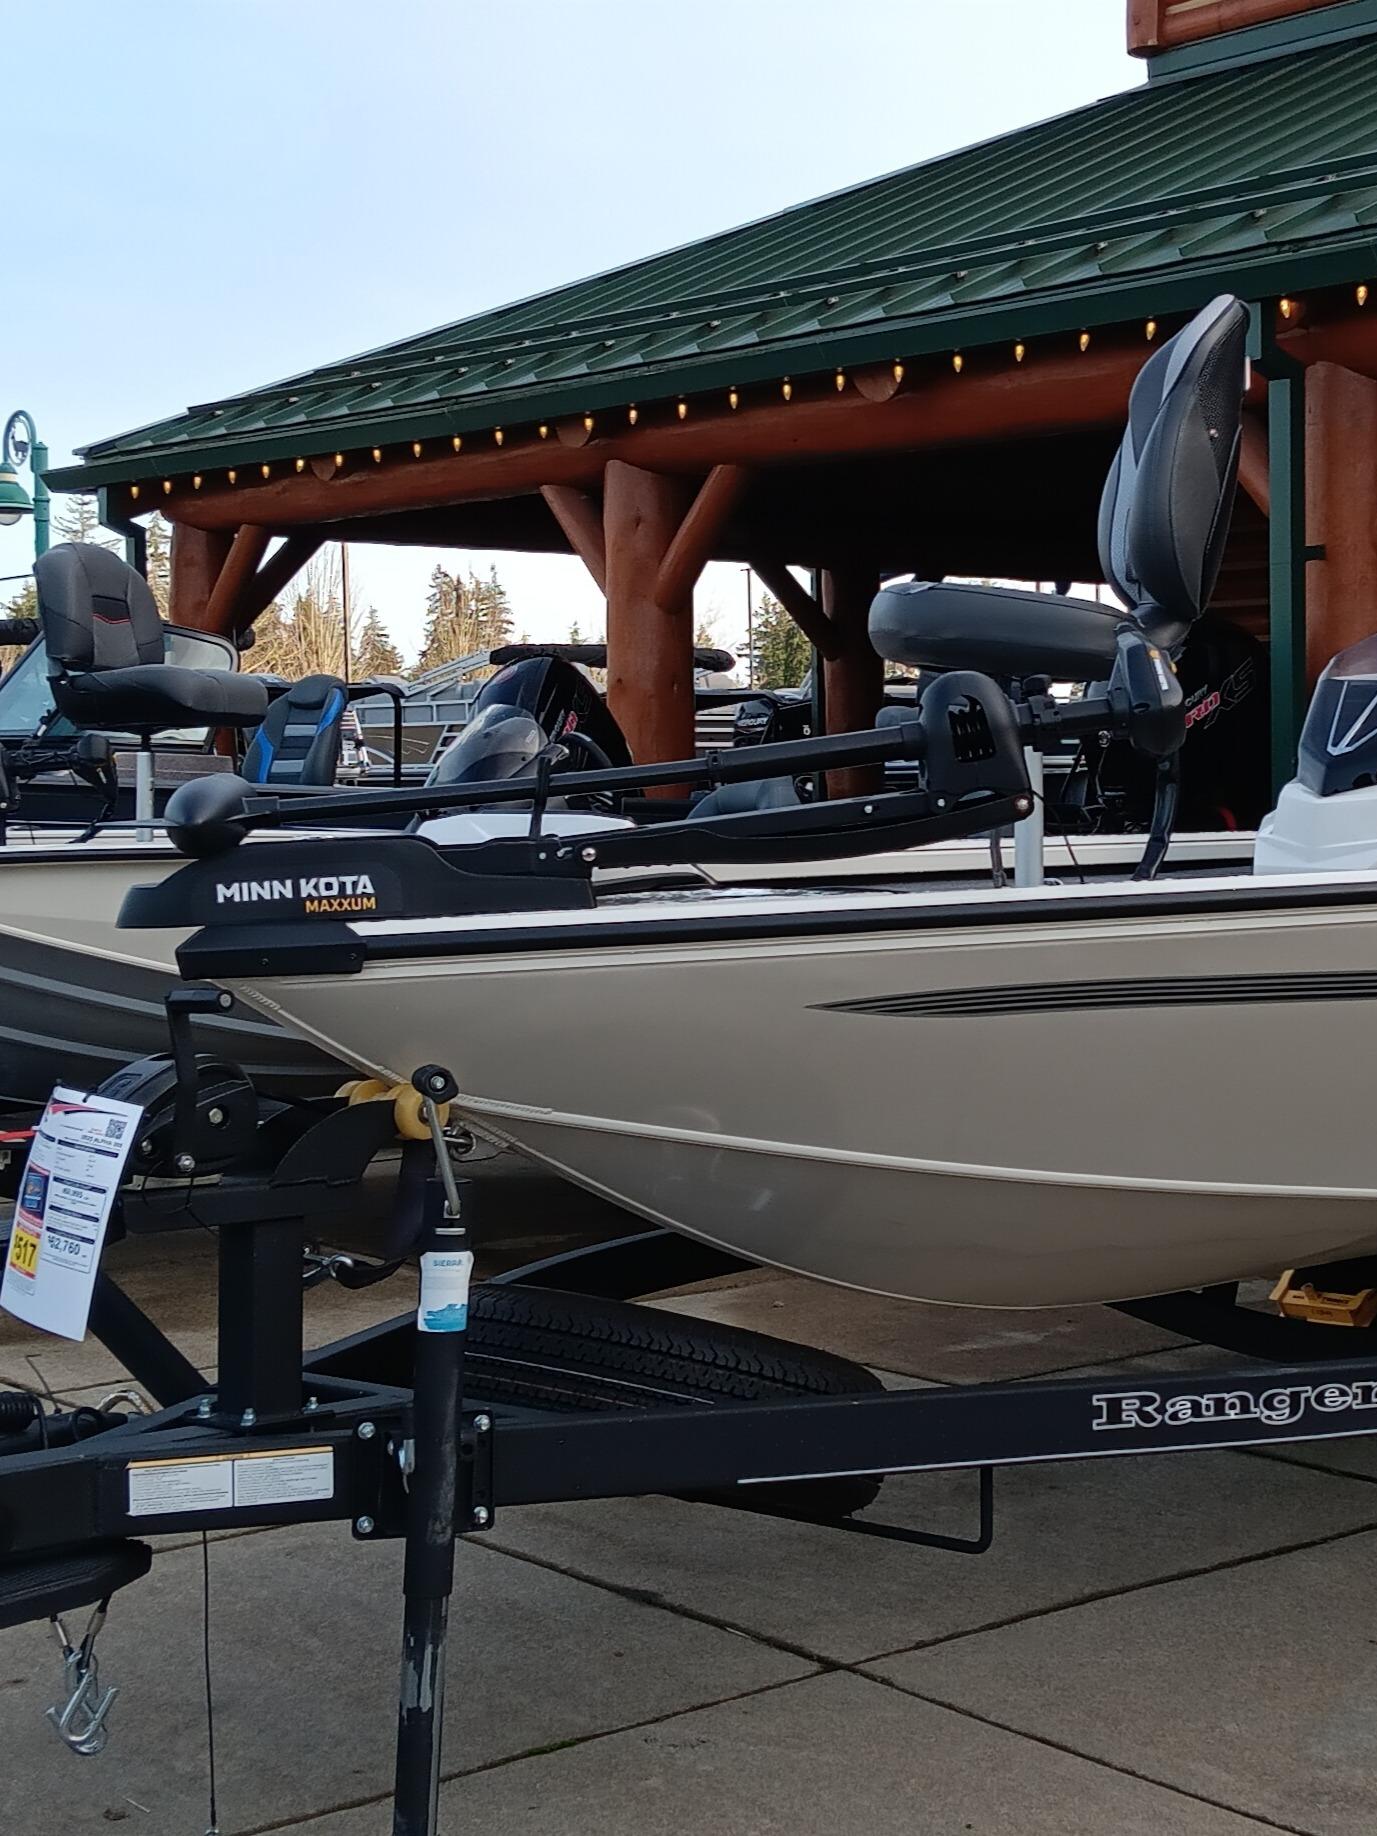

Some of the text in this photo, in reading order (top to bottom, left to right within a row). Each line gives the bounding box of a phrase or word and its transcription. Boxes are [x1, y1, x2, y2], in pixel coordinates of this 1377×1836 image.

[215, 875, 375, 904] MINN KOTA
[305, 897, 377, 913] MAXXUM
